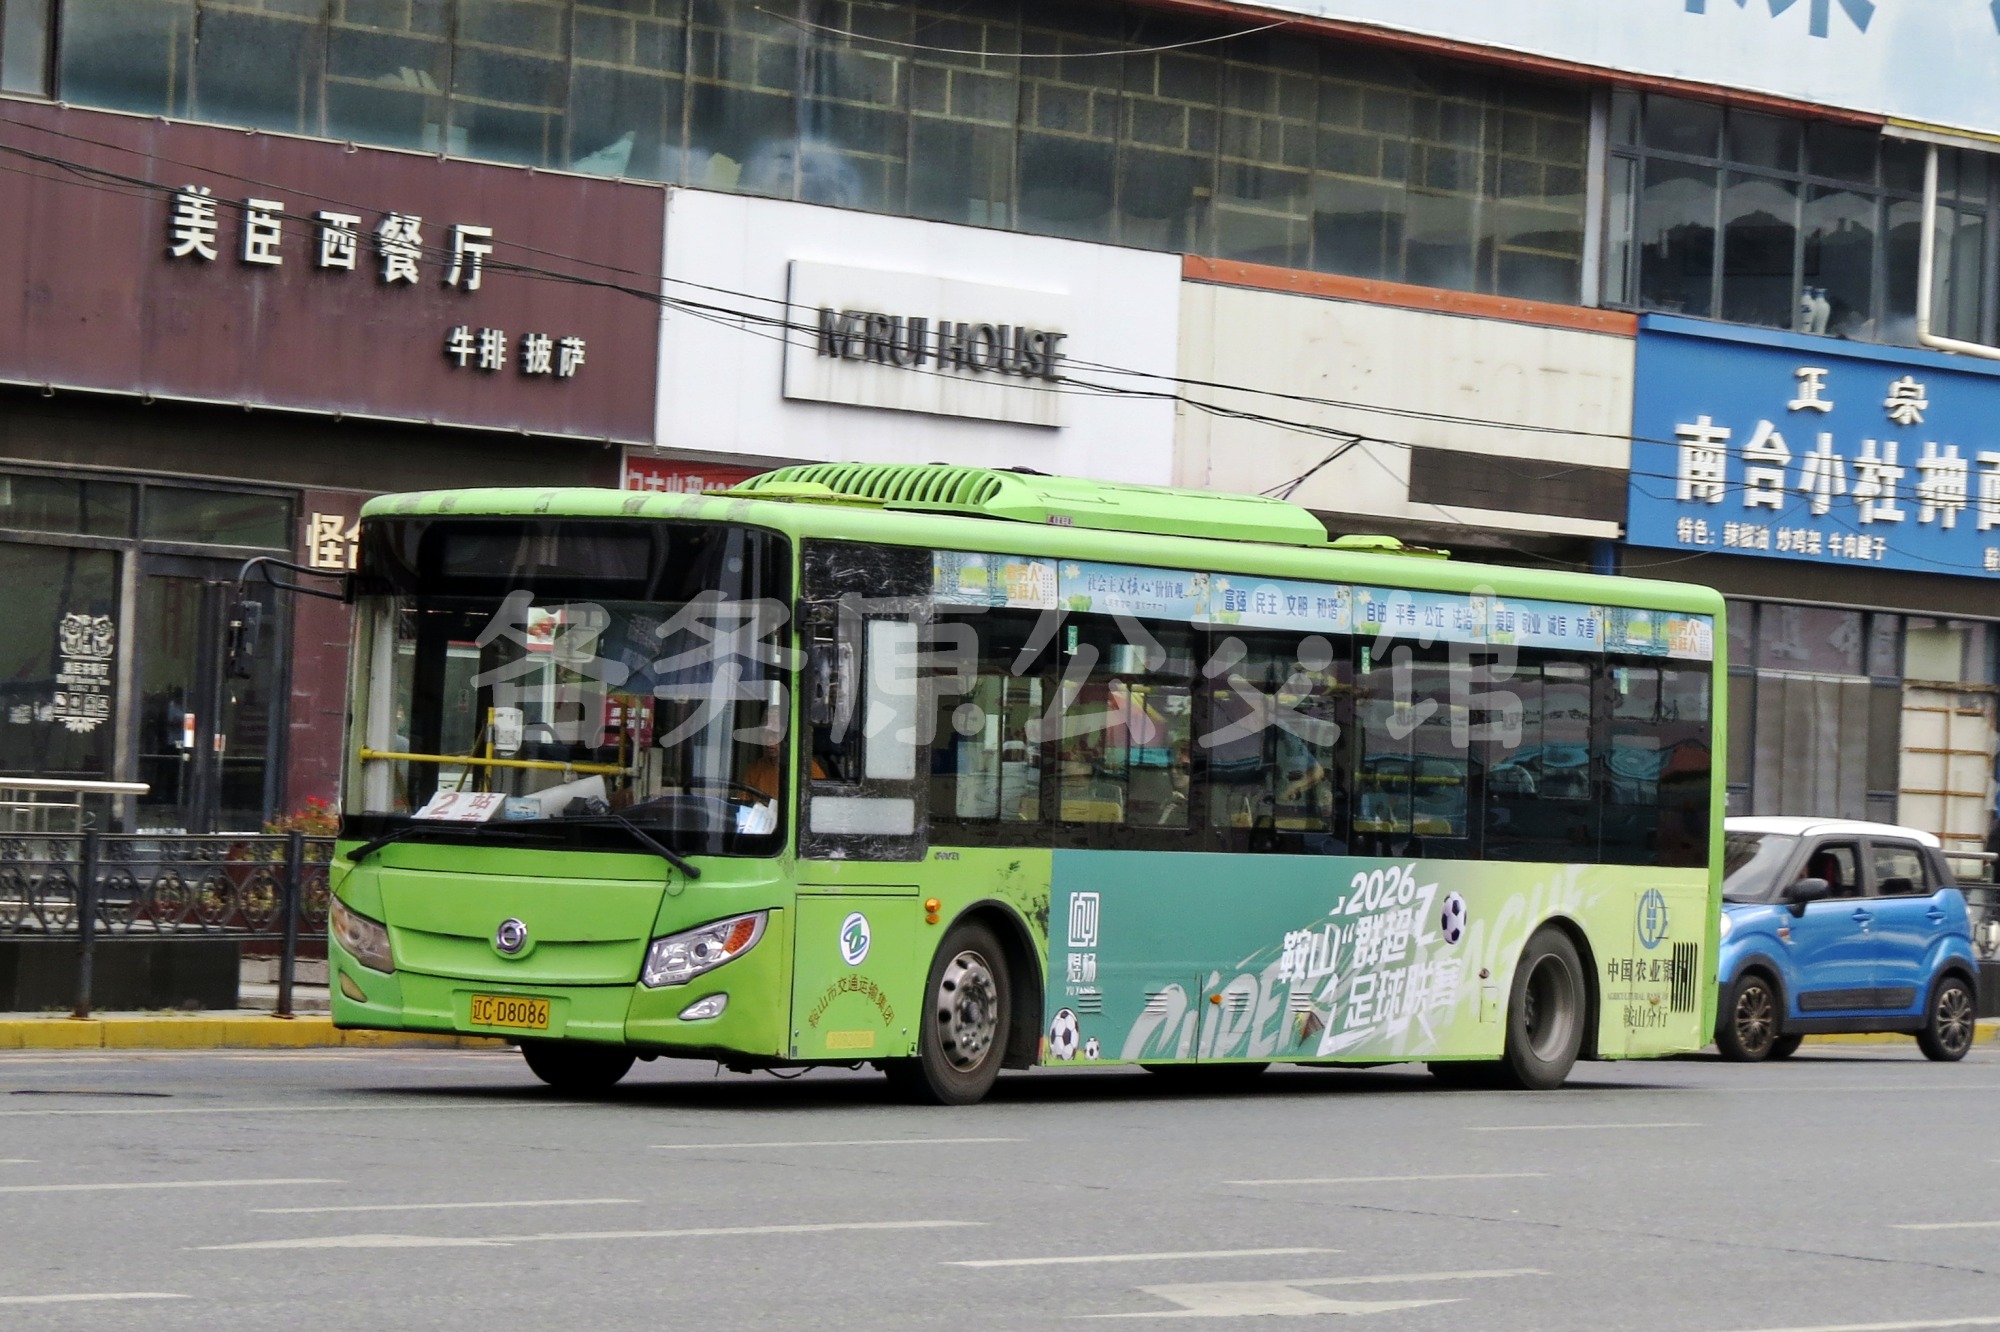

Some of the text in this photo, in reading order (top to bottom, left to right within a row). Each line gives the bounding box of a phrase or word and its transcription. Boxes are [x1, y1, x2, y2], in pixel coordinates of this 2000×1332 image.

[170, 184, 494, 291] 美臣西餐厅
[446, 325, 586, 378] 牛排 披萨
[818, 307, 1068, 382] MERUI HOUSE
[1787, 366, 1930, 425] 正宗
[306, 511, 360, 570] 怪
[1088, 572, 1184, 599] 社会主义核心价值观
[1224, 588, 1338, 620] 富强 民主 文明 和谐
[1366, 600, 1473, 630] 自由 平等 公正 法治
[1495, 610, 1595, 639] 爱国 敬业 诚信 友善
[430, 793, 459, 815] 2
[1343, 862, 1417, 915] 2026
[808, 973, 895, 1028] 鞍山市交通运输集团
[1343, 957, 1462, 1030] 足球联赛
[1623, 1004, 1668, 1028] 鞍山分行
